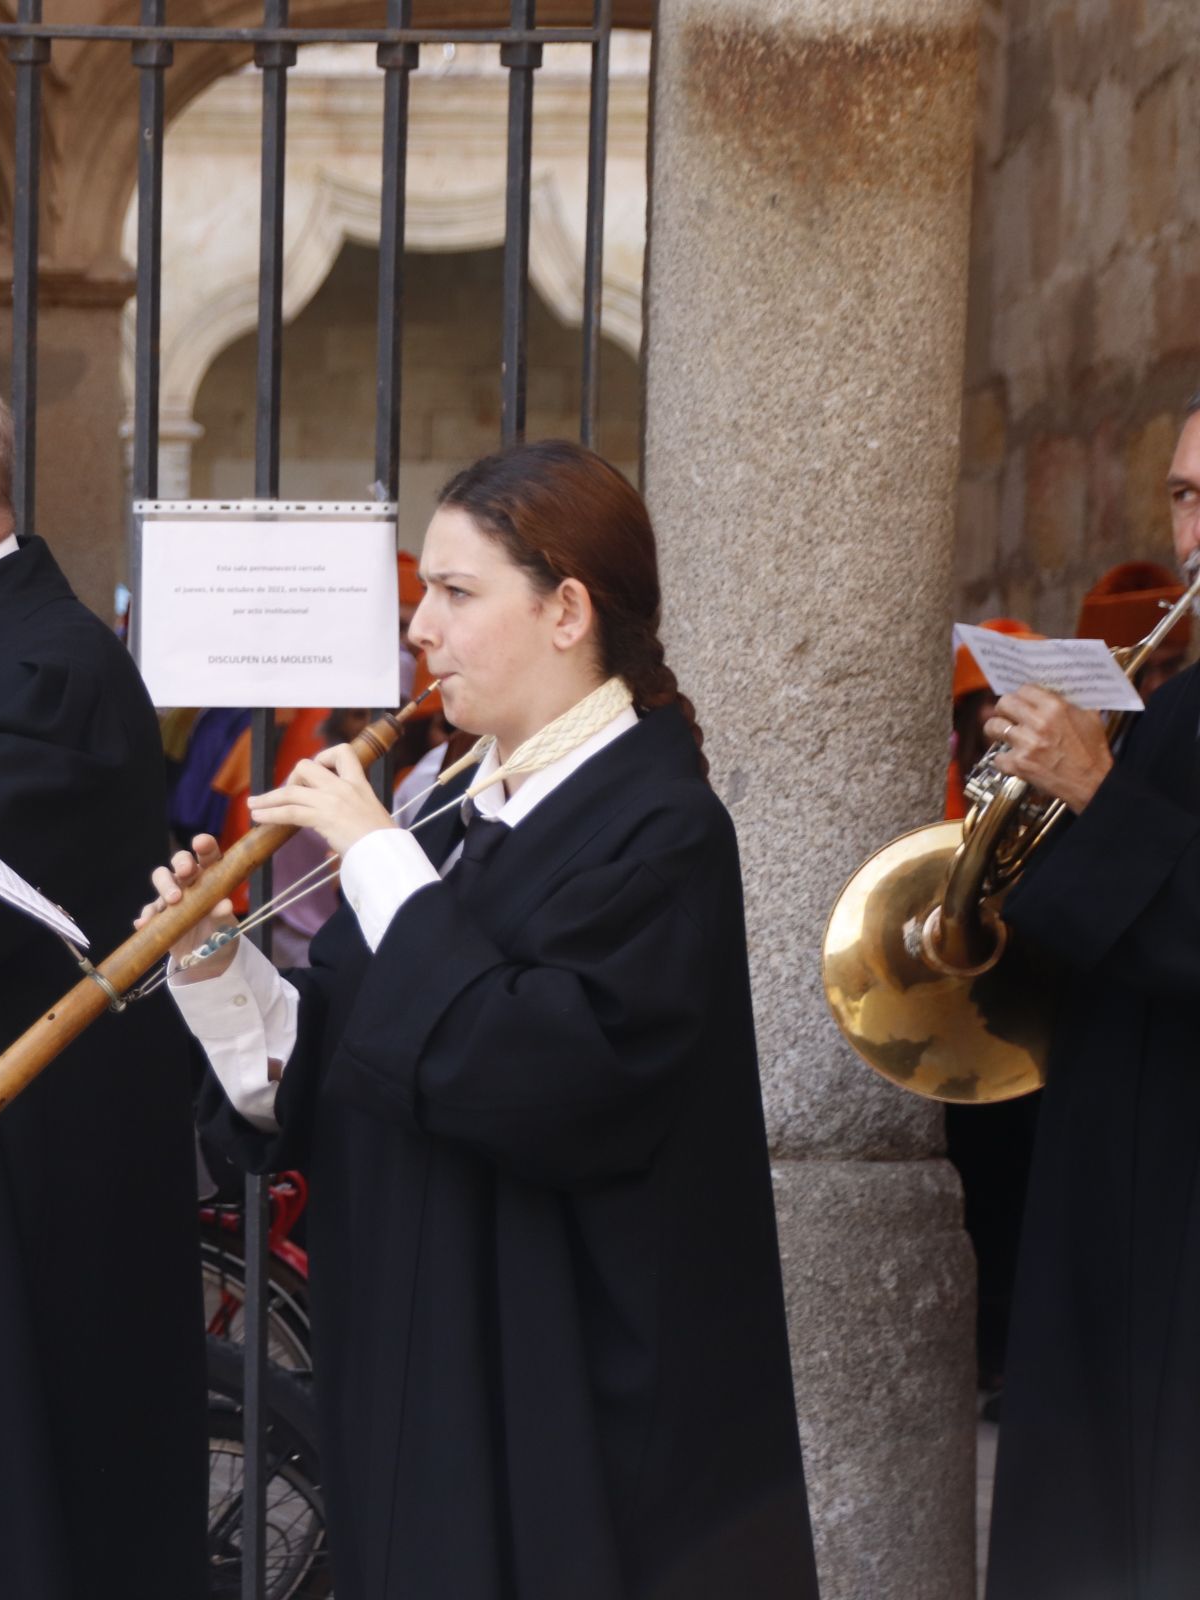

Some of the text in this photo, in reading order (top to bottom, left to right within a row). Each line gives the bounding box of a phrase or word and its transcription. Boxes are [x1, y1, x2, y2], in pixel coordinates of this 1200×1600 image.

[208, 655, 333, 664] DISCULPEN LAS MOLESTIAS
